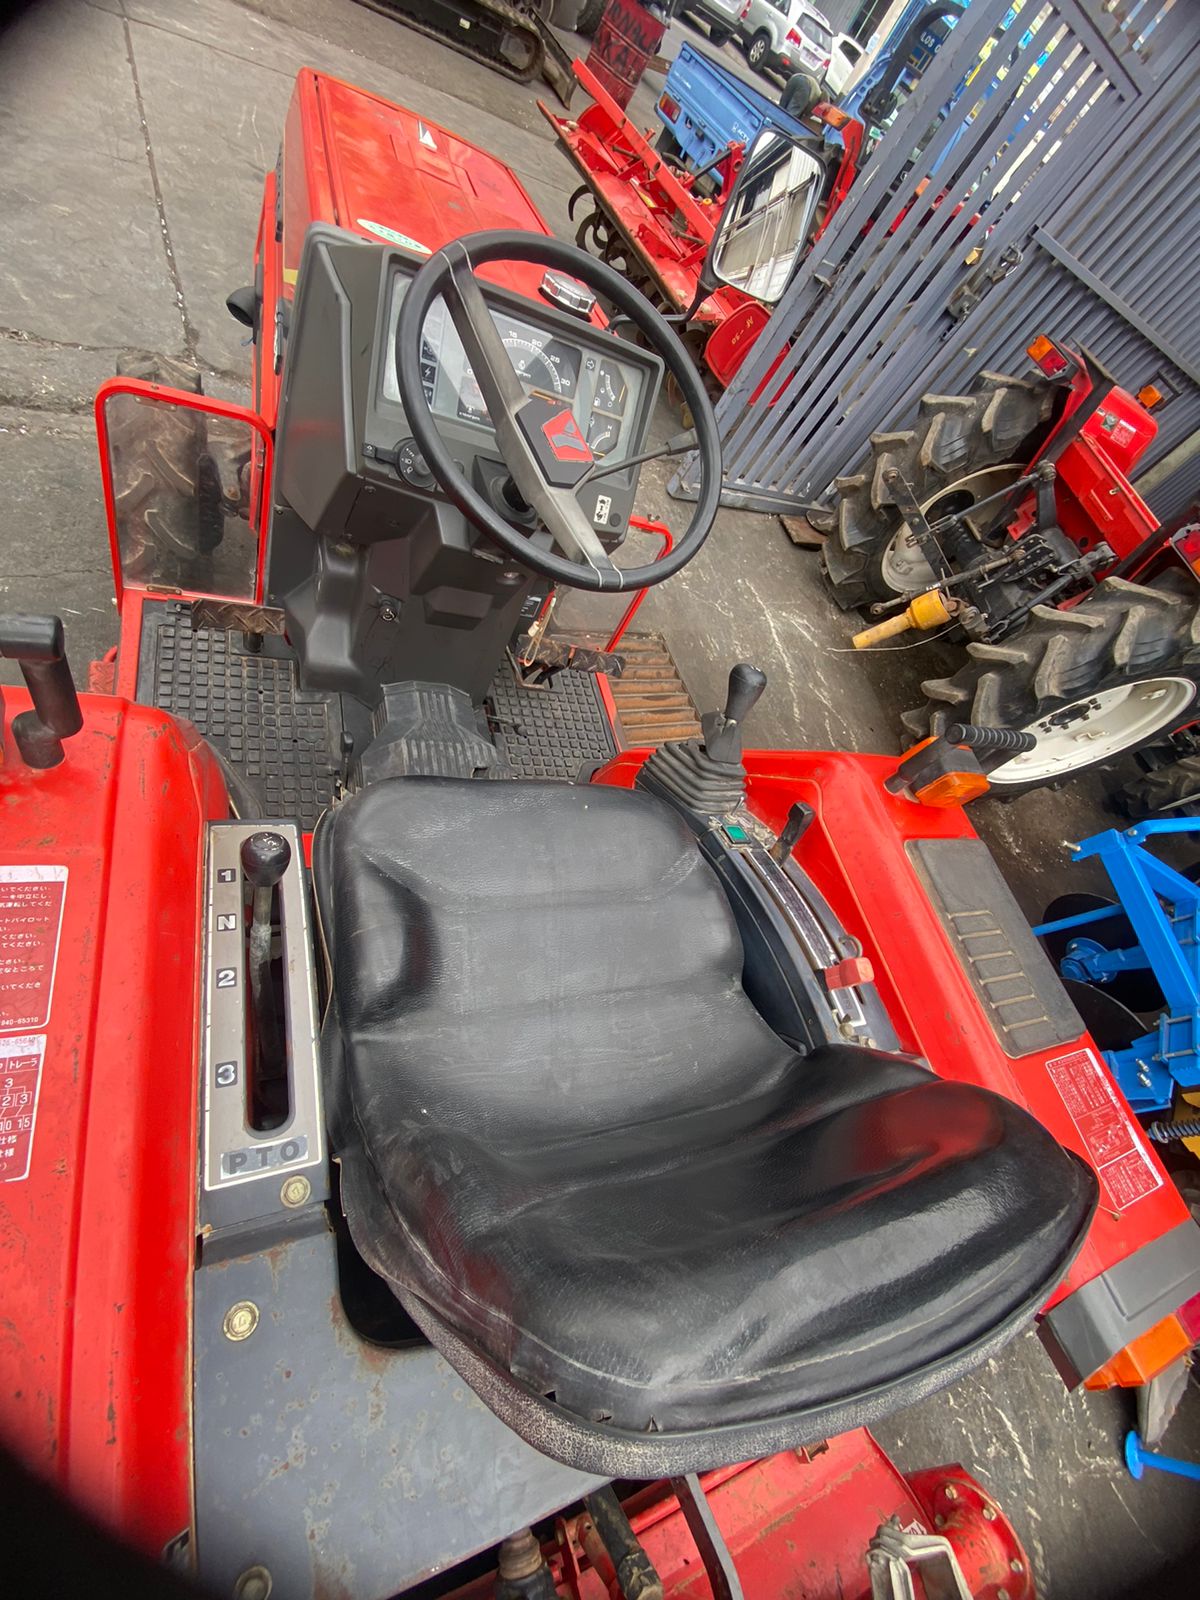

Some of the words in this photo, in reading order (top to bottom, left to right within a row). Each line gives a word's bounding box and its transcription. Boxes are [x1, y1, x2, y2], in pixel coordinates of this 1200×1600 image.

[221, 870, 232, 882] 1
[217, 915, 236, 931] N
[217, 970, 236, 987] 2
[217, 1064, 236, 1085] 3
[5, 1078, 14, 1089] 3
[2, 1096, 11, 1107] 2
[19, 1093, 28, 1105] 3
